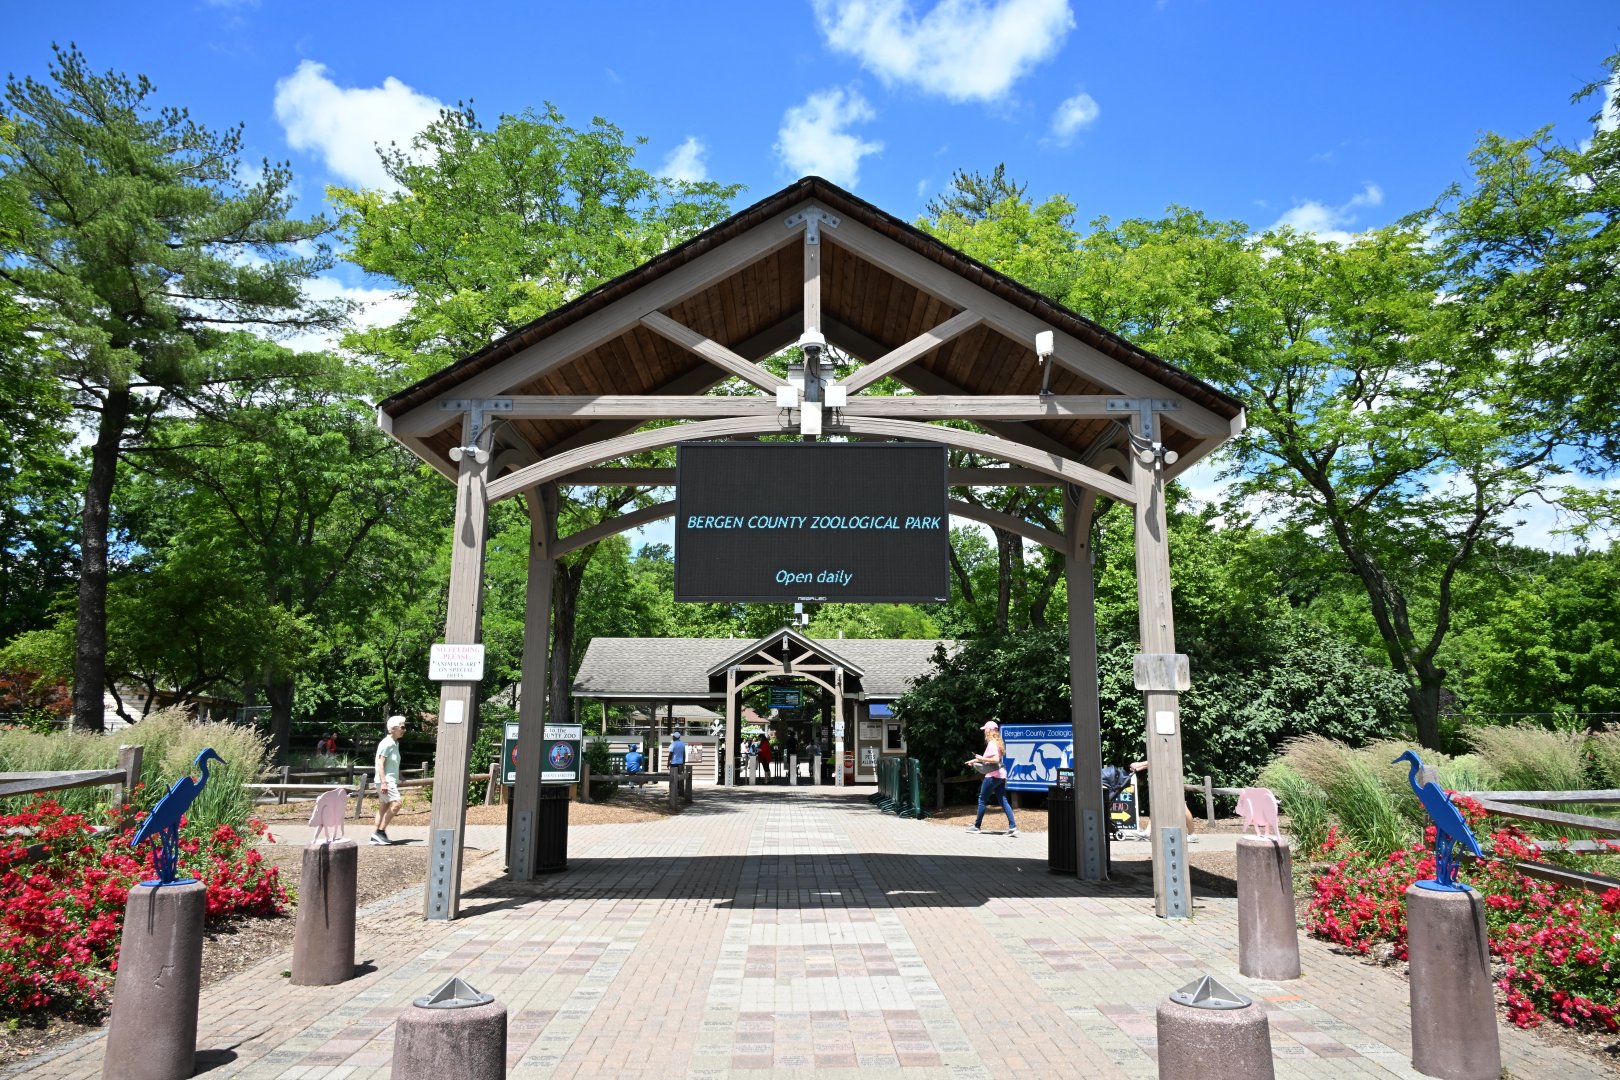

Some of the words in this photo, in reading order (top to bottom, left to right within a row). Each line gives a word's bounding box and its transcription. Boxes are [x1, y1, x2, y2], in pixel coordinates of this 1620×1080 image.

[687, 516, 744, 529] BERGEN
[747, 516, 807, 529] COUNTY
[810, 516, 900, 529] ZOOLOGICAL
[904, 516, 941, 529] PARK
[775, 570, 813, 586] Open
[816, 570, 853, 586] daily
[1004, 729, 1024, 738] Bergen
[1025, 729, 1045, 738] County
